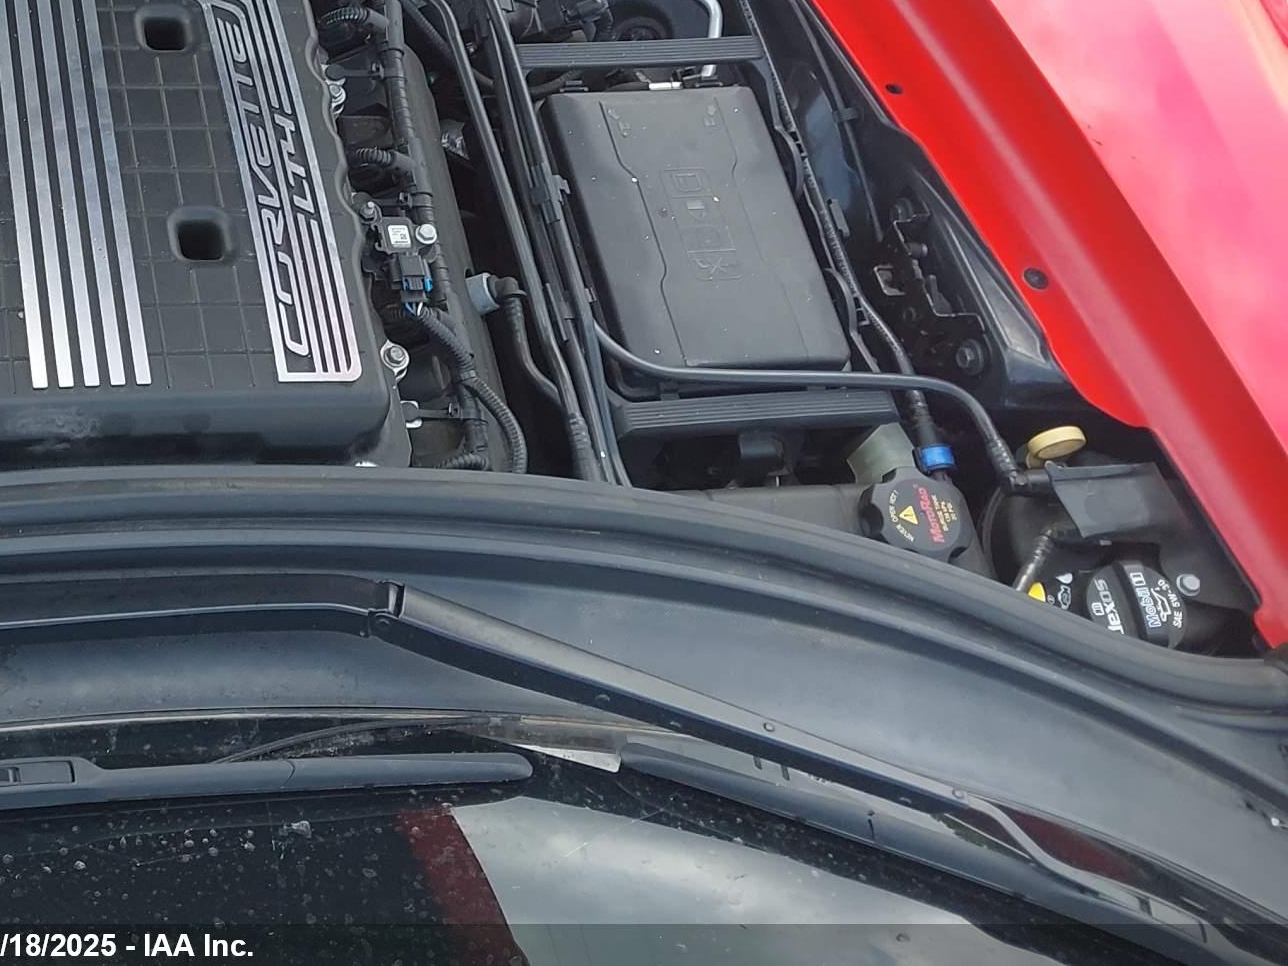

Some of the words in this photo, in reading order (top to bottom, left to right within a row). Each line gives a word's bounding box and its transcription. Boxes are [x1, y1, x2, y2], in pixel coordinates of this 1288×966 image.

[273, 113, 314, 214] LT4
[216, 17, 310, 357] CORVETTE
[1135, 587, 1162, 628] Mobil
[1157, 579, 1181, 608] 5W-30
[1172, 611, 1183, 628] SAE
